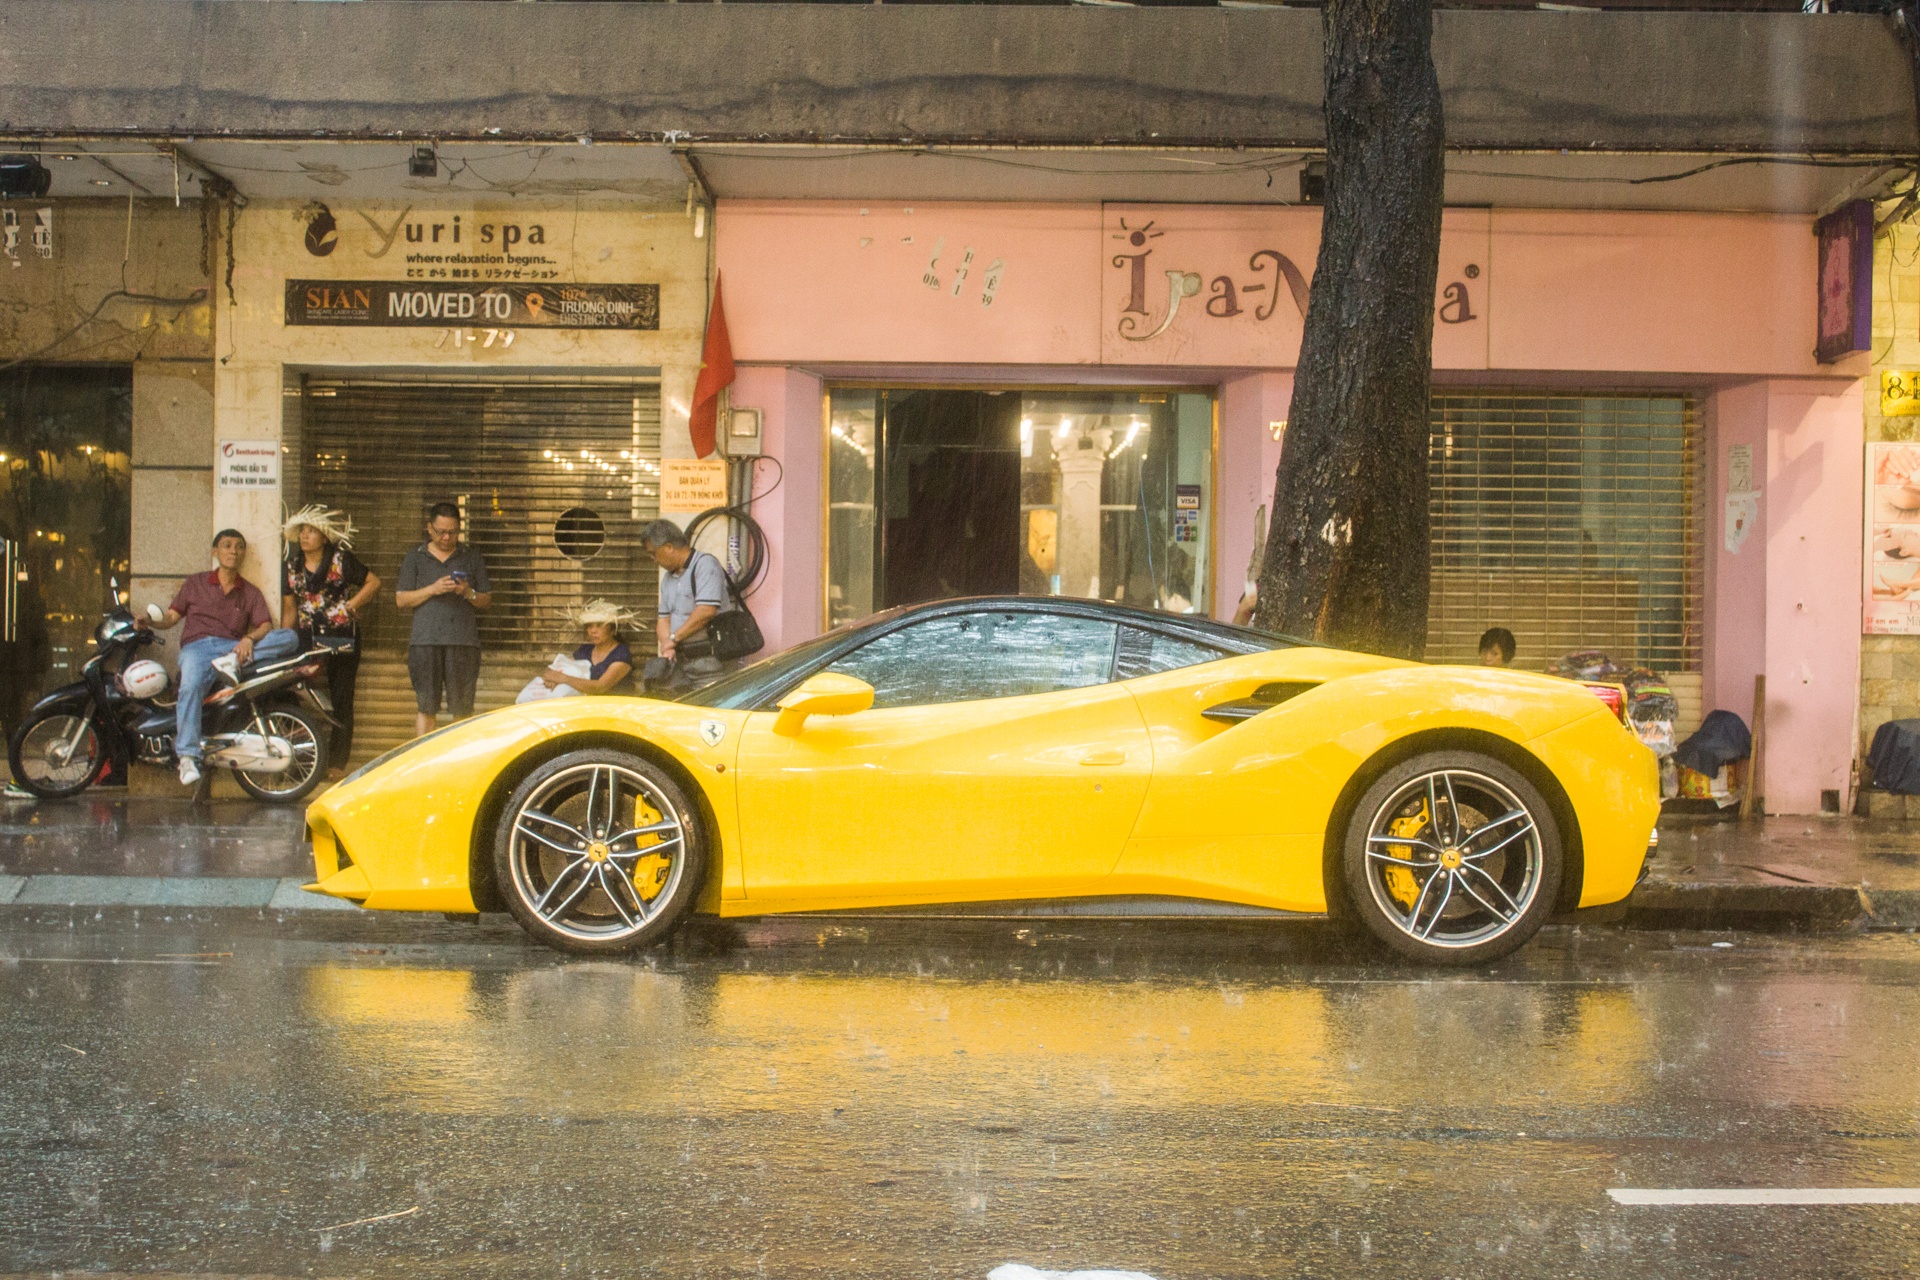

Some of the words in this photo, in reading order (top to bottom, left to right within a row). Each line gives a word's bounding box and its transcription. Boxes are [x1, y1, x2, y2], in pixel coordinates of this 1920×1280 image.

[356, 204, 461, 258] Yuri
[481, 223, 545, 253] spa
[406, 253, 442, 264] where
[445, 253, 504, 264] relaxation
[306, 287, 371, 309] SIAN
[388, 292, 475, 318] MOVED
[480, 293, 511, 319] TO
[559, 300, 605, 314] TRUONG
[607, 301, 634, 314] DINH
[560, 313, 607, 326] DISTRICT
[610, 314, 618, 326] 3
